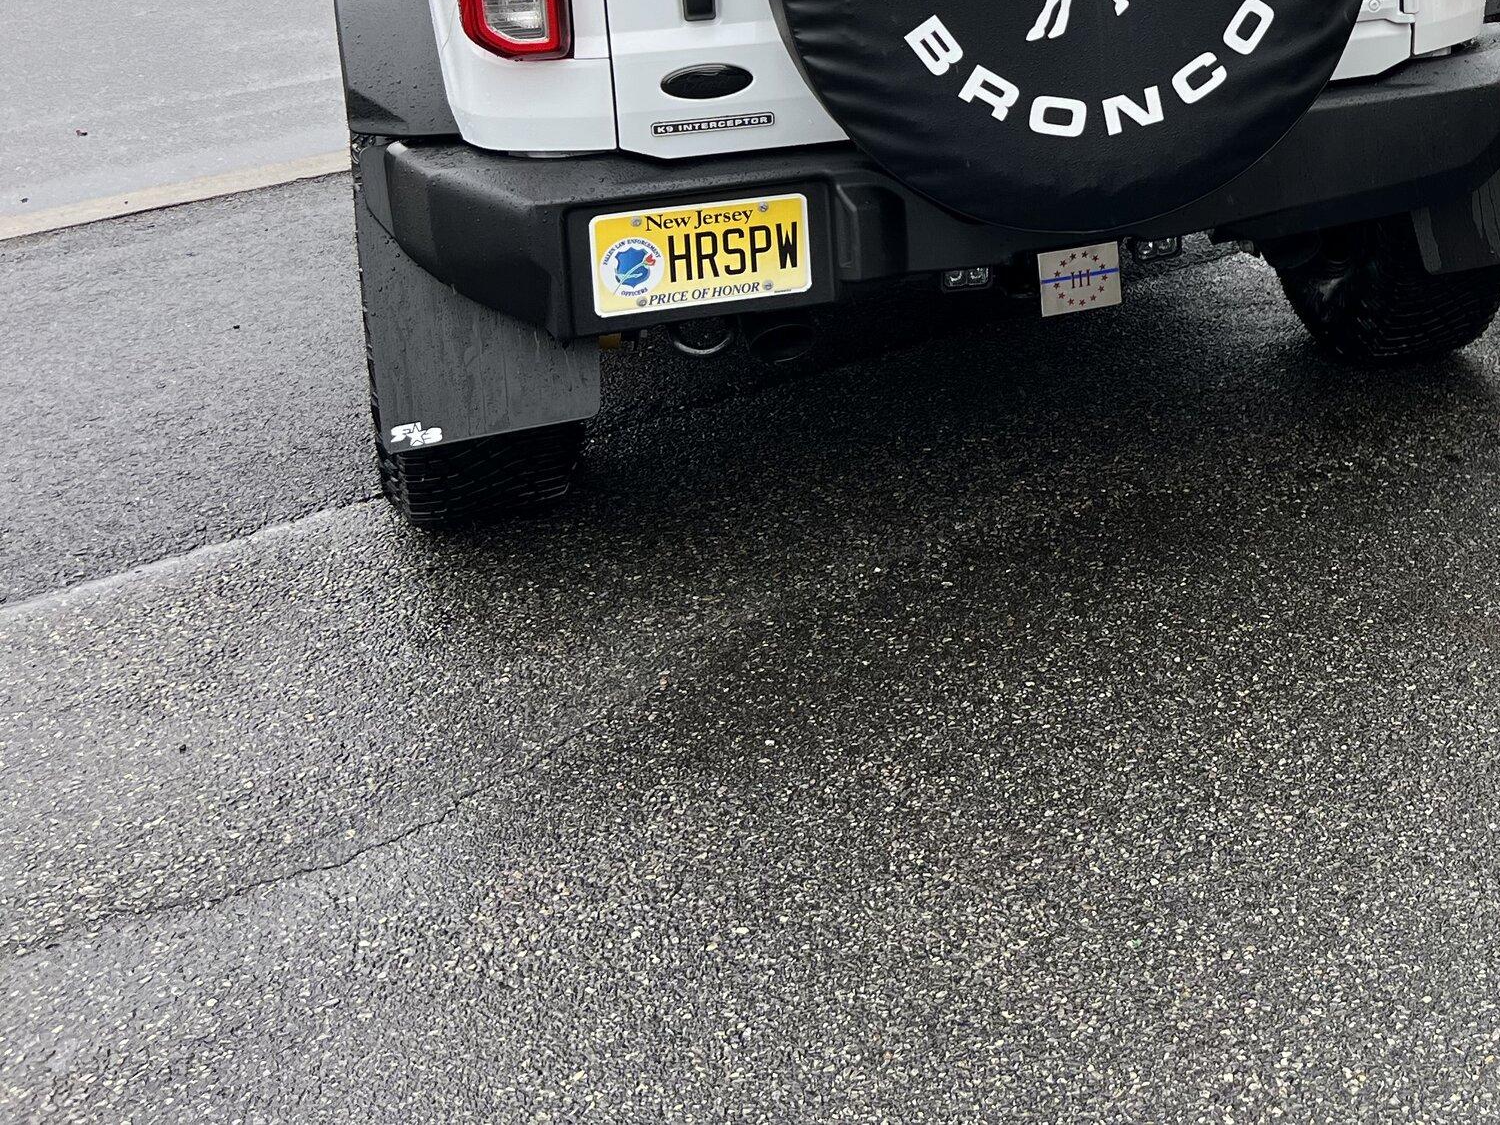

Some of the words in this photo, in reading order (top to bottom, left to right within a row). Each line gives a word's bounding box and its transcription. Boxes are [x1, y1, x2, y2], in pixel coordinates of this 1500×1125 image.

[657, 125, 674, 134] K9
[678, 116, 768, 132] INTERCEPTOR
[645, 214, 691, 232] New
[694, 208, 753, 229] Jersey
[603, 248, 616, 266] FALLEN
[614, 239, 626, 250] LAW
[626, 238, 662, 258] ENFORCEMENT
[667, 221, 798, 283] HRSPW
[620, 286, 648, 297] OFFICERS
[648, 290, 688, 306] PRICE
[692, 288, 709, 300] OF
[712, 281, 760, 298] HONOR
